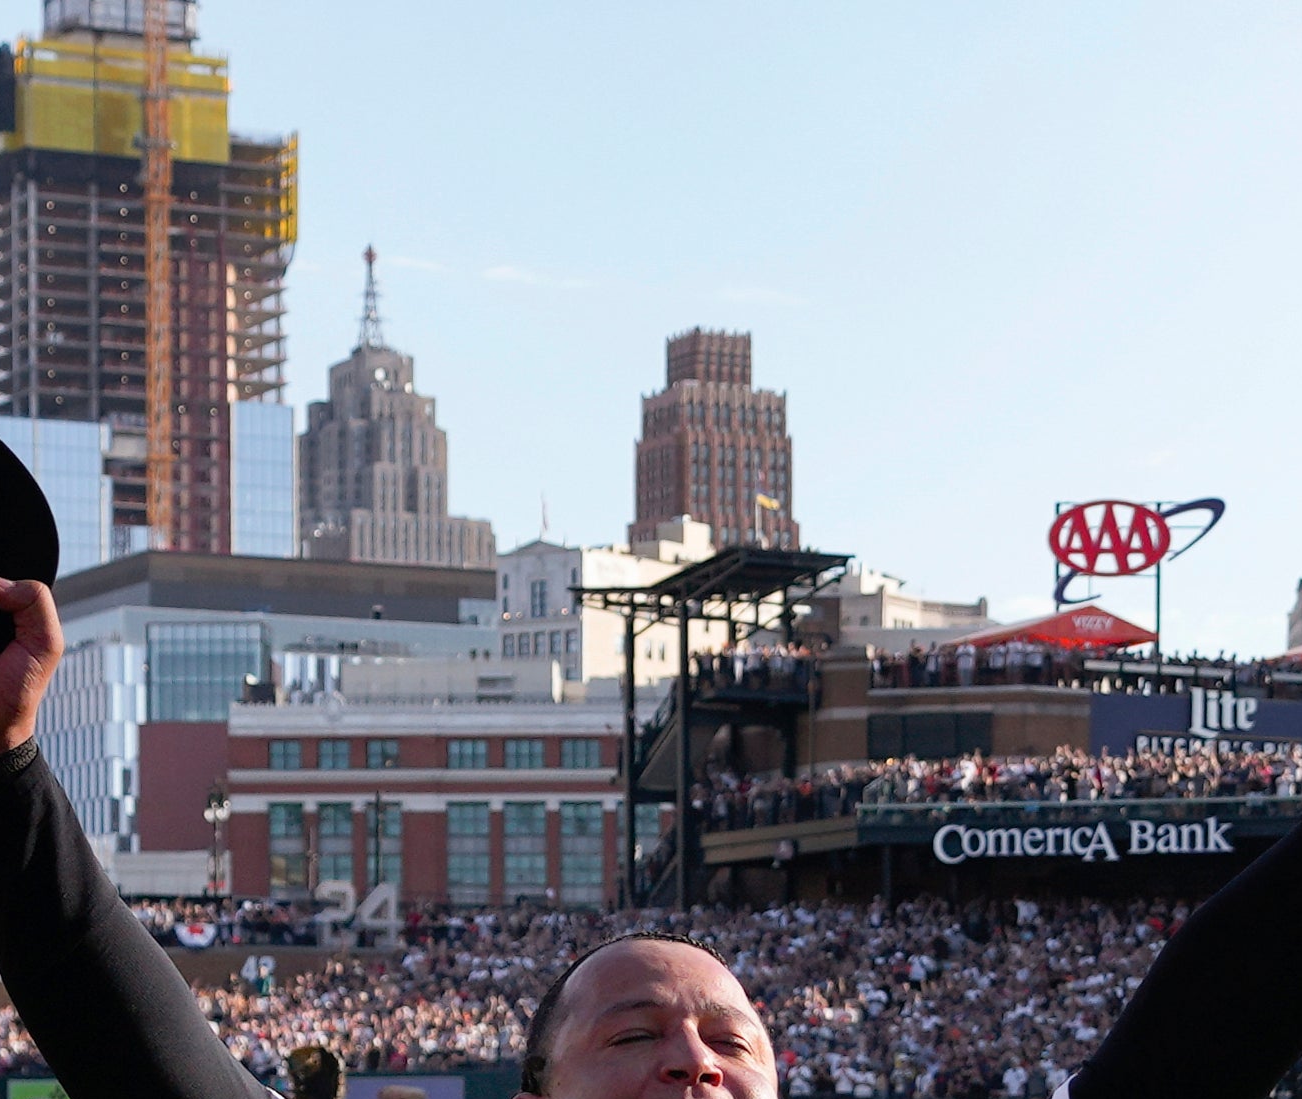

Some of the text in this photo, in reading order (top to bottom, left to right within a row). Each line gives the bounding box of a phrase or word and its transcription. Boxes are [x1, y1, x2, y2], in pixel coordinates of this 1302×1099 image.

[1049, 500, 1171, 576] AAA
[1189, 687, 1258, 738] Lite
[1127, 815, 1235, 854] Bank
[314, 880, 405, 948] 24
